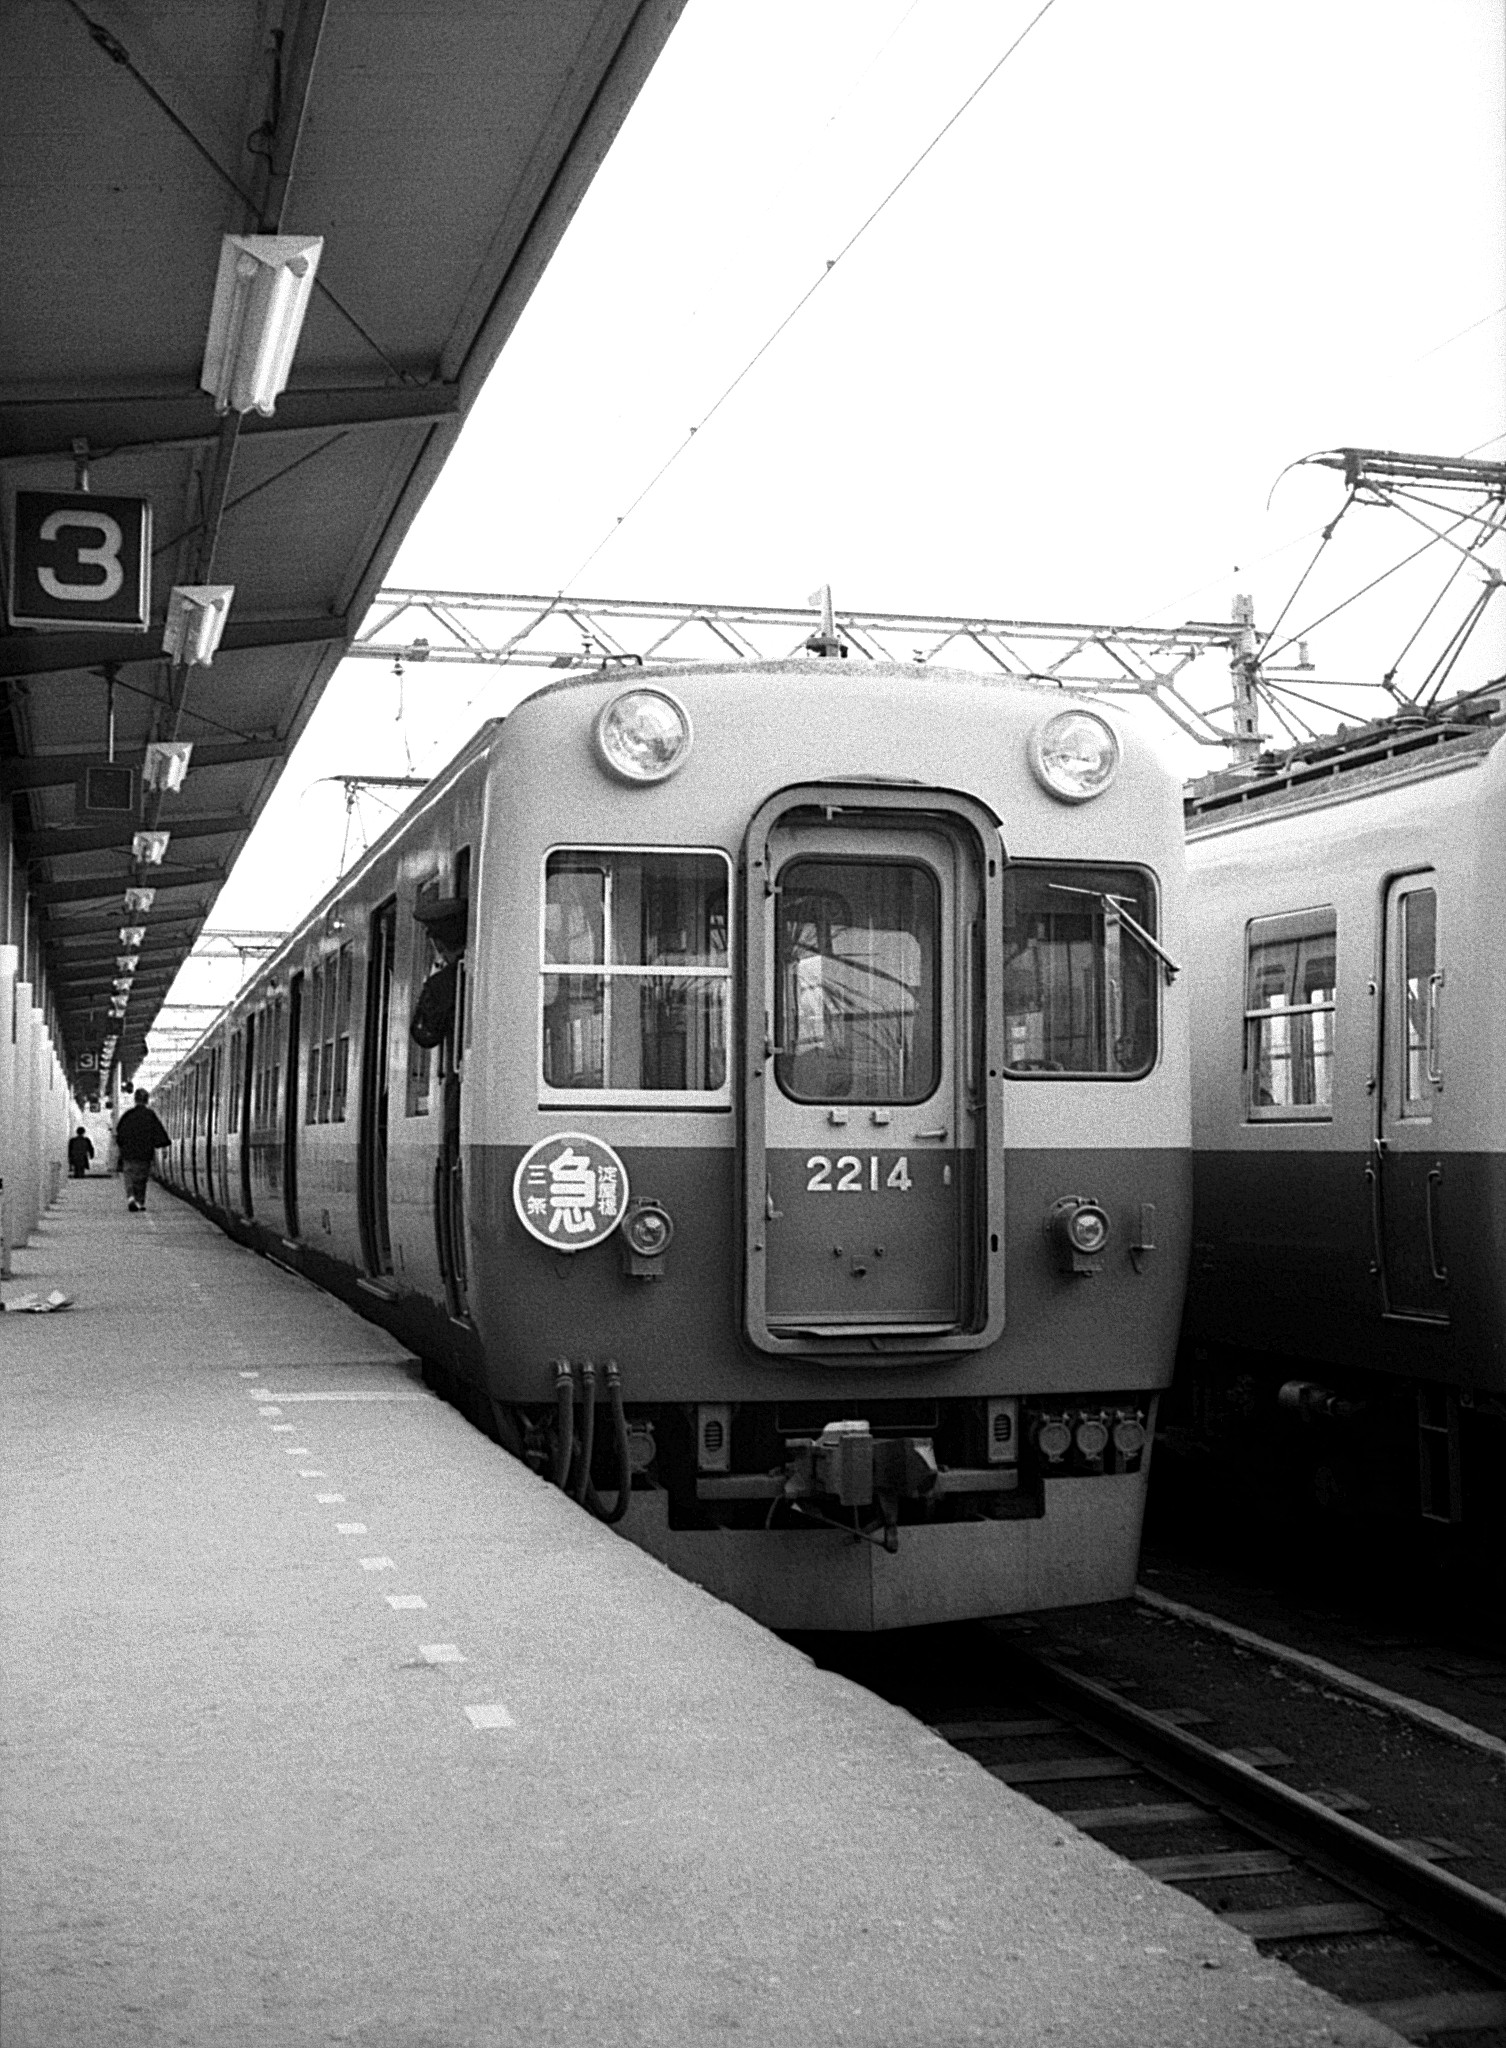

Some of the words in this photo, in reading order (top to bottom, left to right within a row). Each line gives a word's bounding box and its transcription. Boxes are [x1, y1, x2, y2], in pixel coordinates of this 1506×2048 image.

[37, 510, 124, 601] 3
[80, 1053, 94, 1068] 3
[548, 1147, 597, 1234] 急
[806, 1155, 912, 1192] 2214
